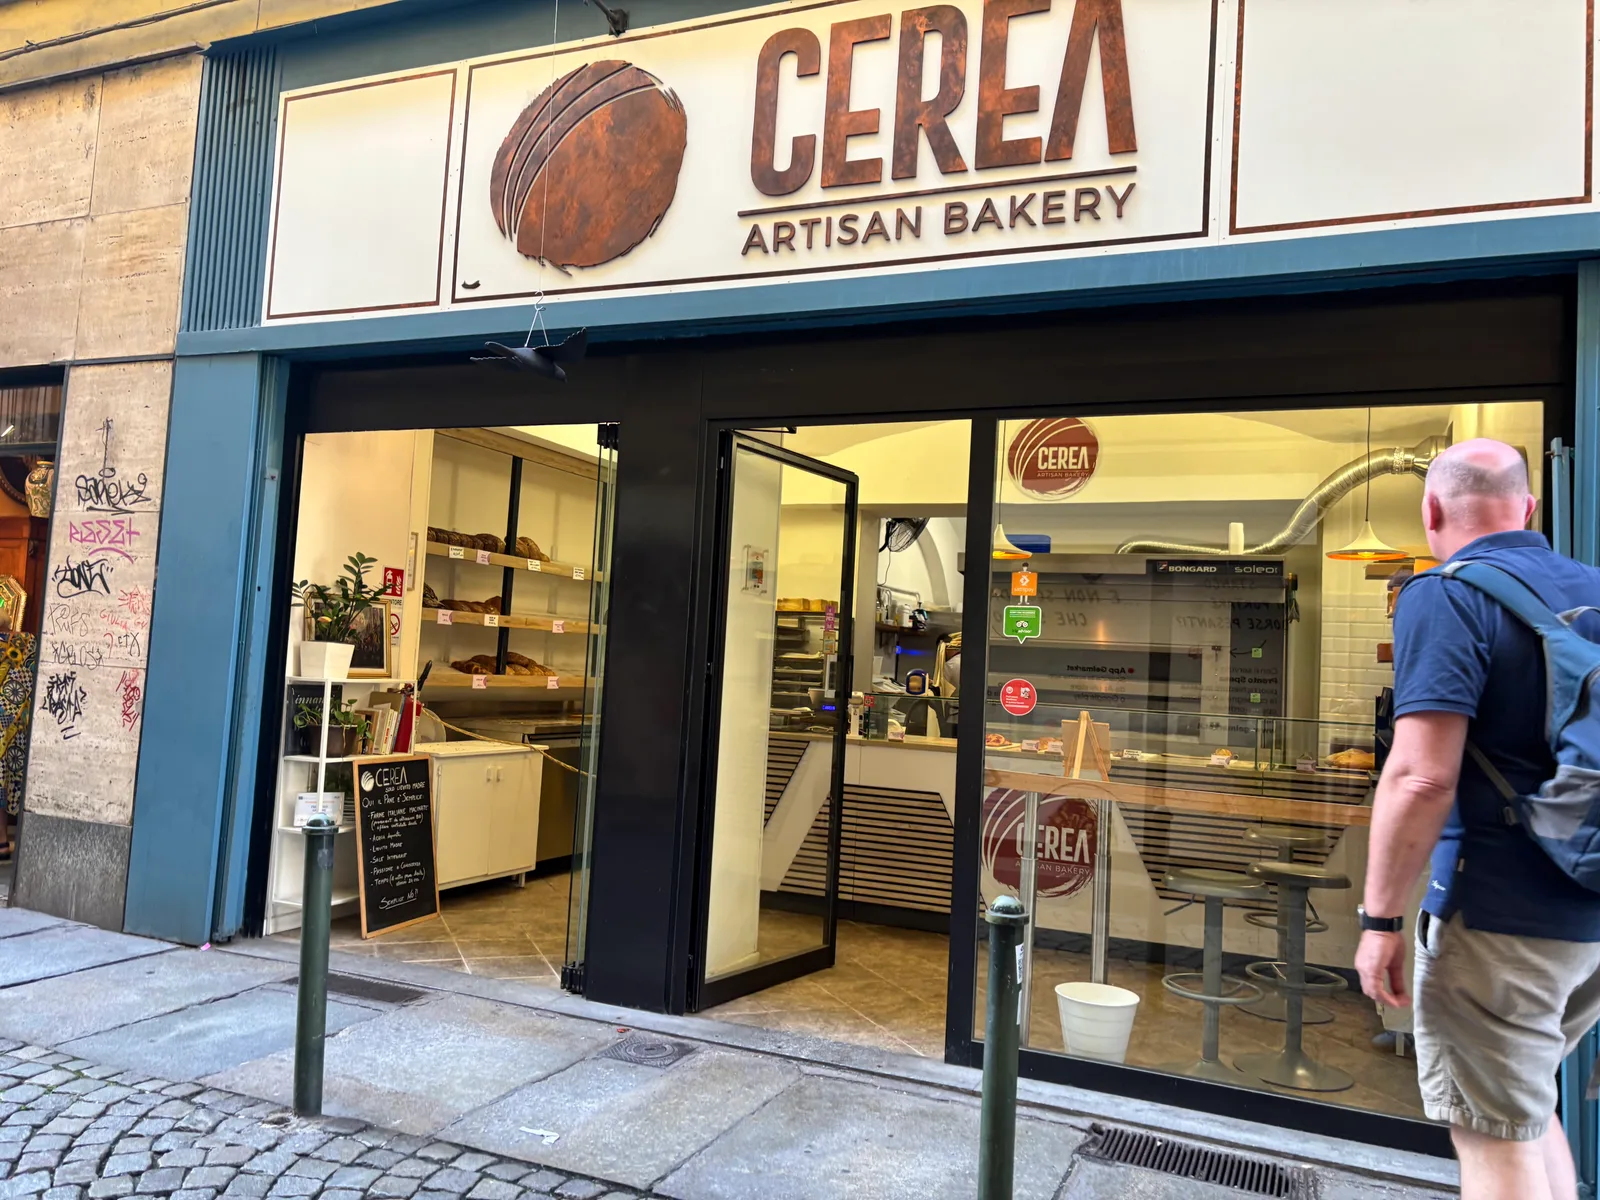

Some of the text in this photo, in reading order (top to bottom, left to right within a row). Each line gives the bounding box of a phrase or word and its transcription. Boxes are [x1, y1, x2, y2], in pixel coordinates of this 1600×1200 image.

[751, 0, 1138, 197] CEREA
[741, 183, 1137, 256] ARTISAN BAKERY
[1037, 446, 1089, 470] CEREA
[1168, 565, 1217, 573] BONGARD
[375, 766, 408, 787] CEREA
[1055, 865, 1090, 876] BAKERY
